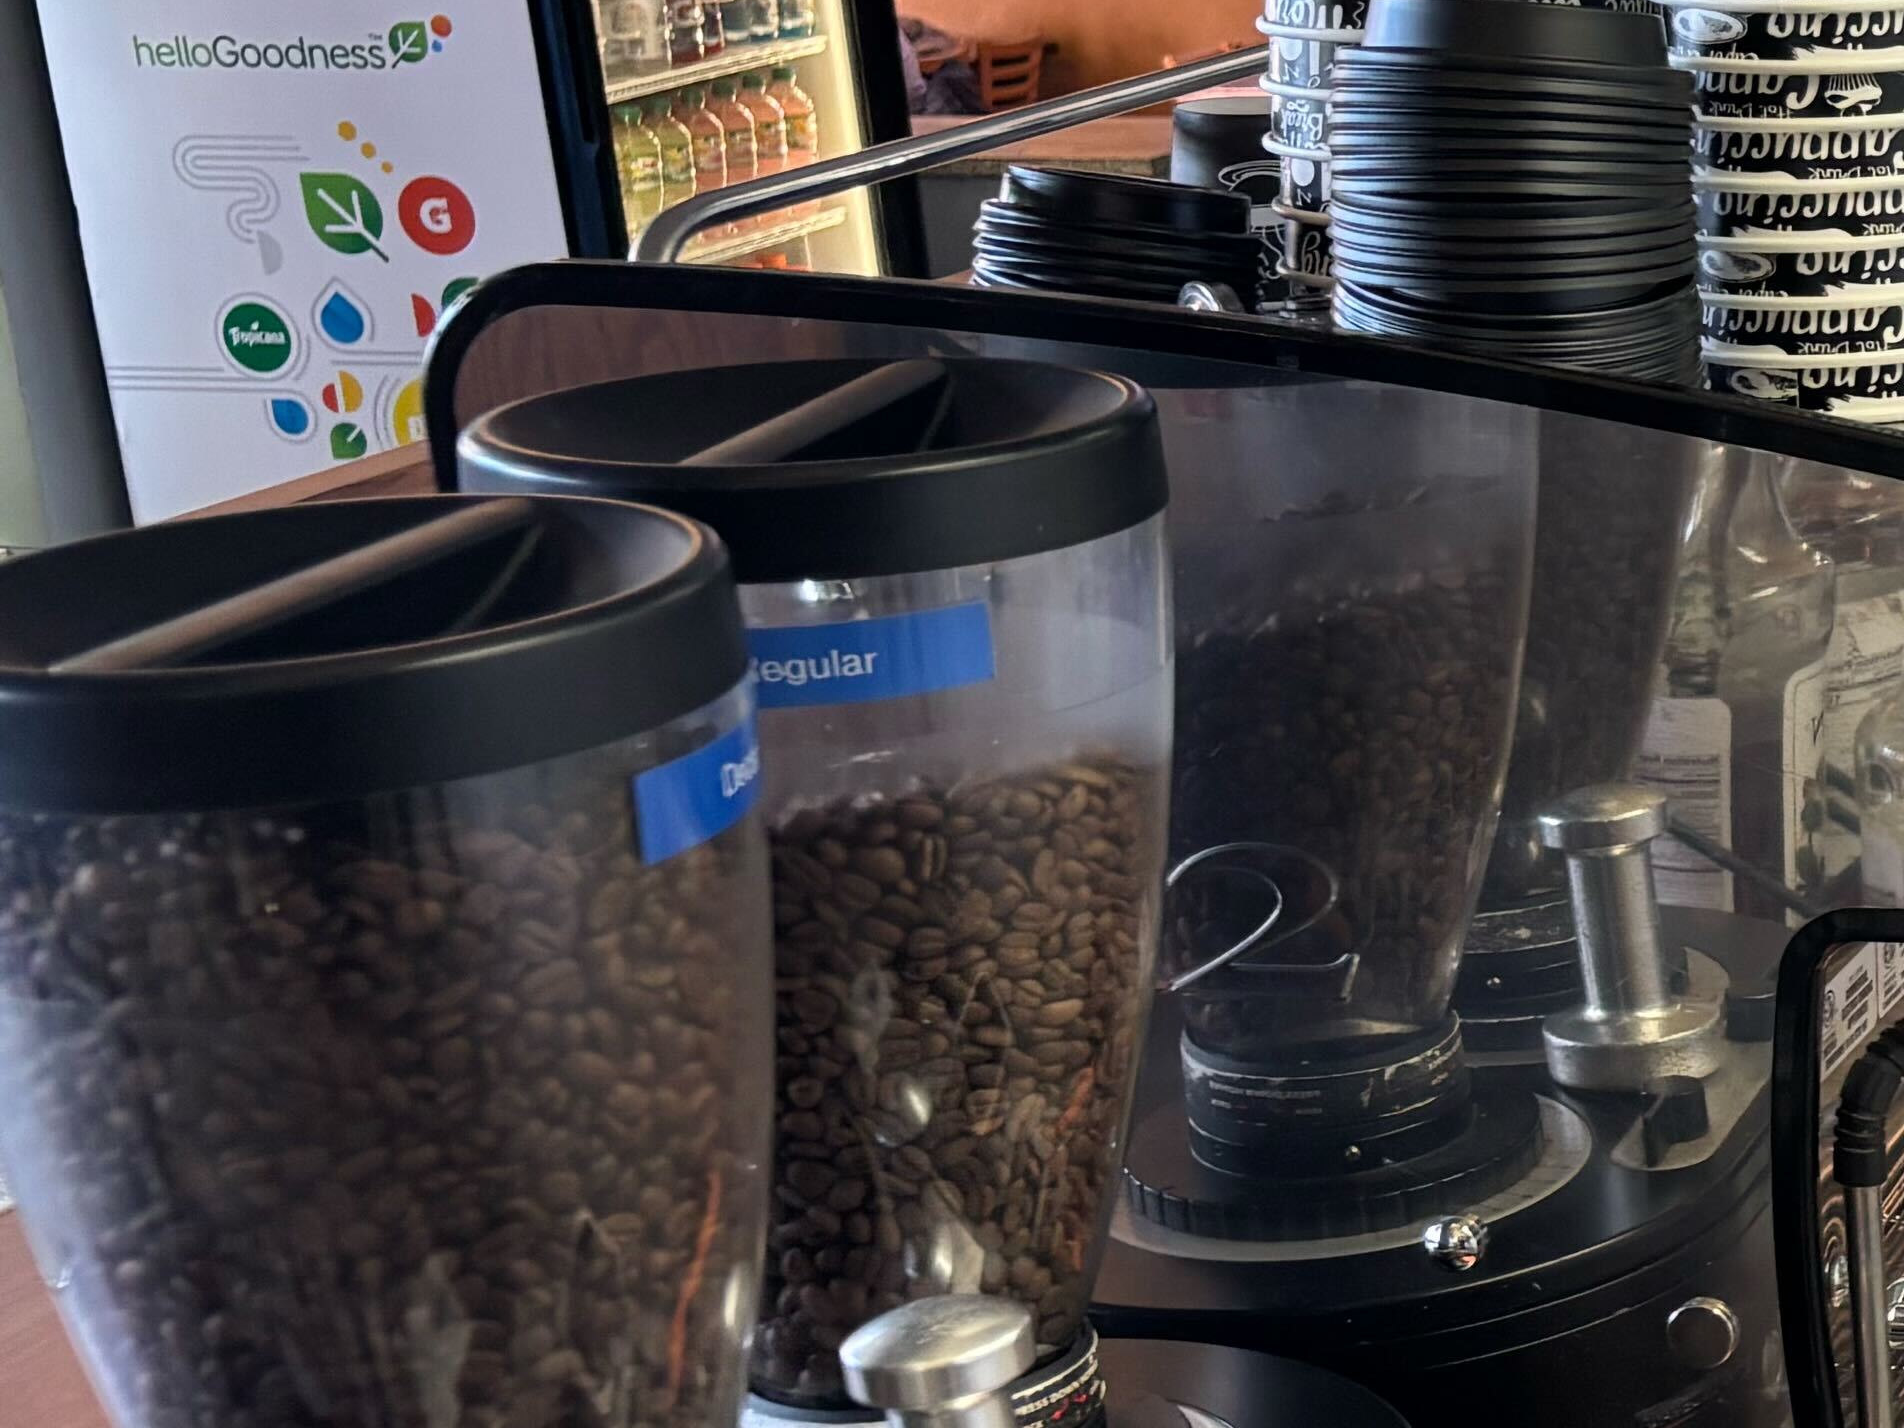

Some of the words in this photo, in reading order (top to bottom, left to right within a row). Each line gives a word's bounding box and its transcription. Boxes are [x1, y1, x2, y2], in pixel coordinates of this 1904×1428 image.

[132, 34, 386, 70] helloGoodness
[418, 197, 452, 234] G
[227, 322, 287, 349] Tropicana
[750, 649, 879, 686] egular
